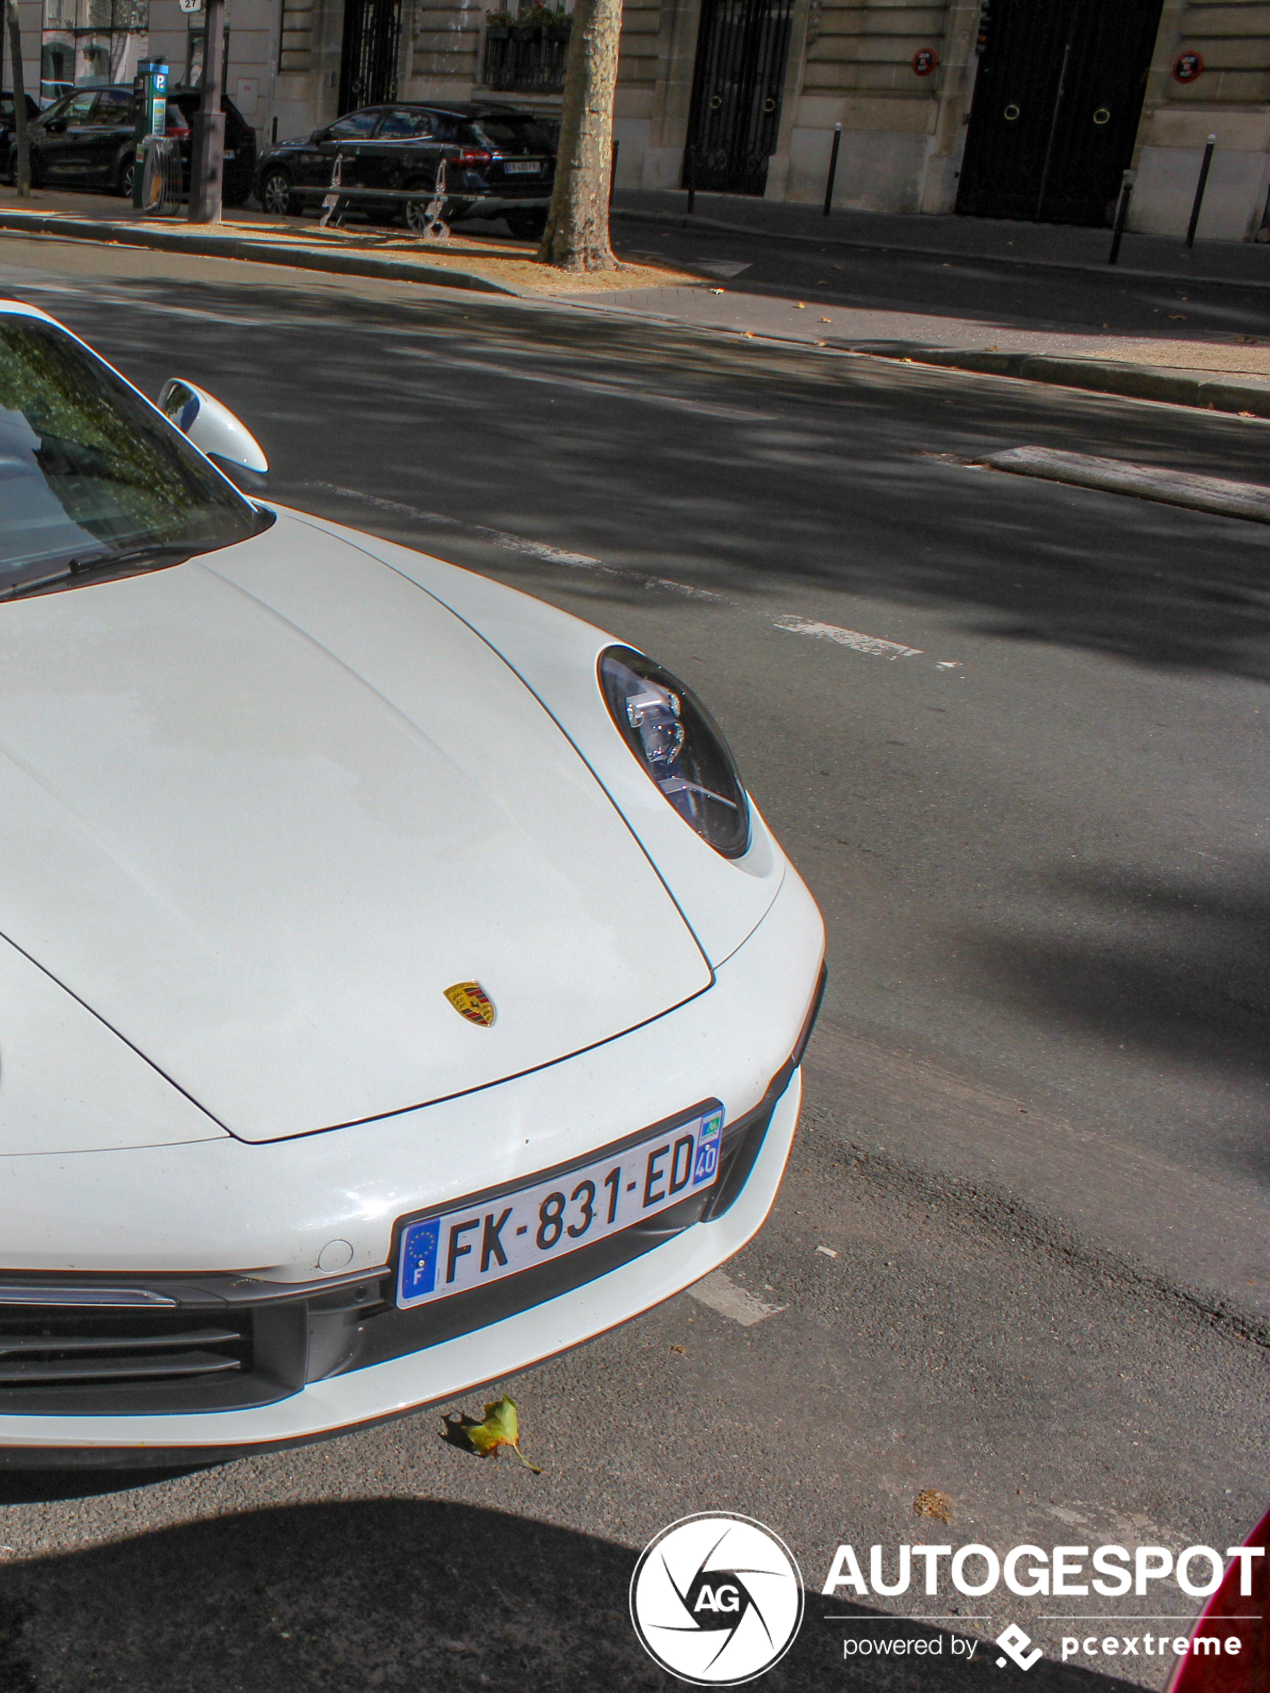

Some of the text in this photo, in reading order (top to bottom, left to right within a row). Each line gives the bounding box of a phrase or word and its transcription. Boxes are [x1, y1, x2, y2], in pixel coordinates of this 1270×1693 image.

[185, 0, 195, 8] 27
[156, 74, 164, 89] P
[413, 1267, 424, 1285] F
[446, 1134, 694, 1284] FK-831-ED
[695, 1147, 717, 1177] 40
